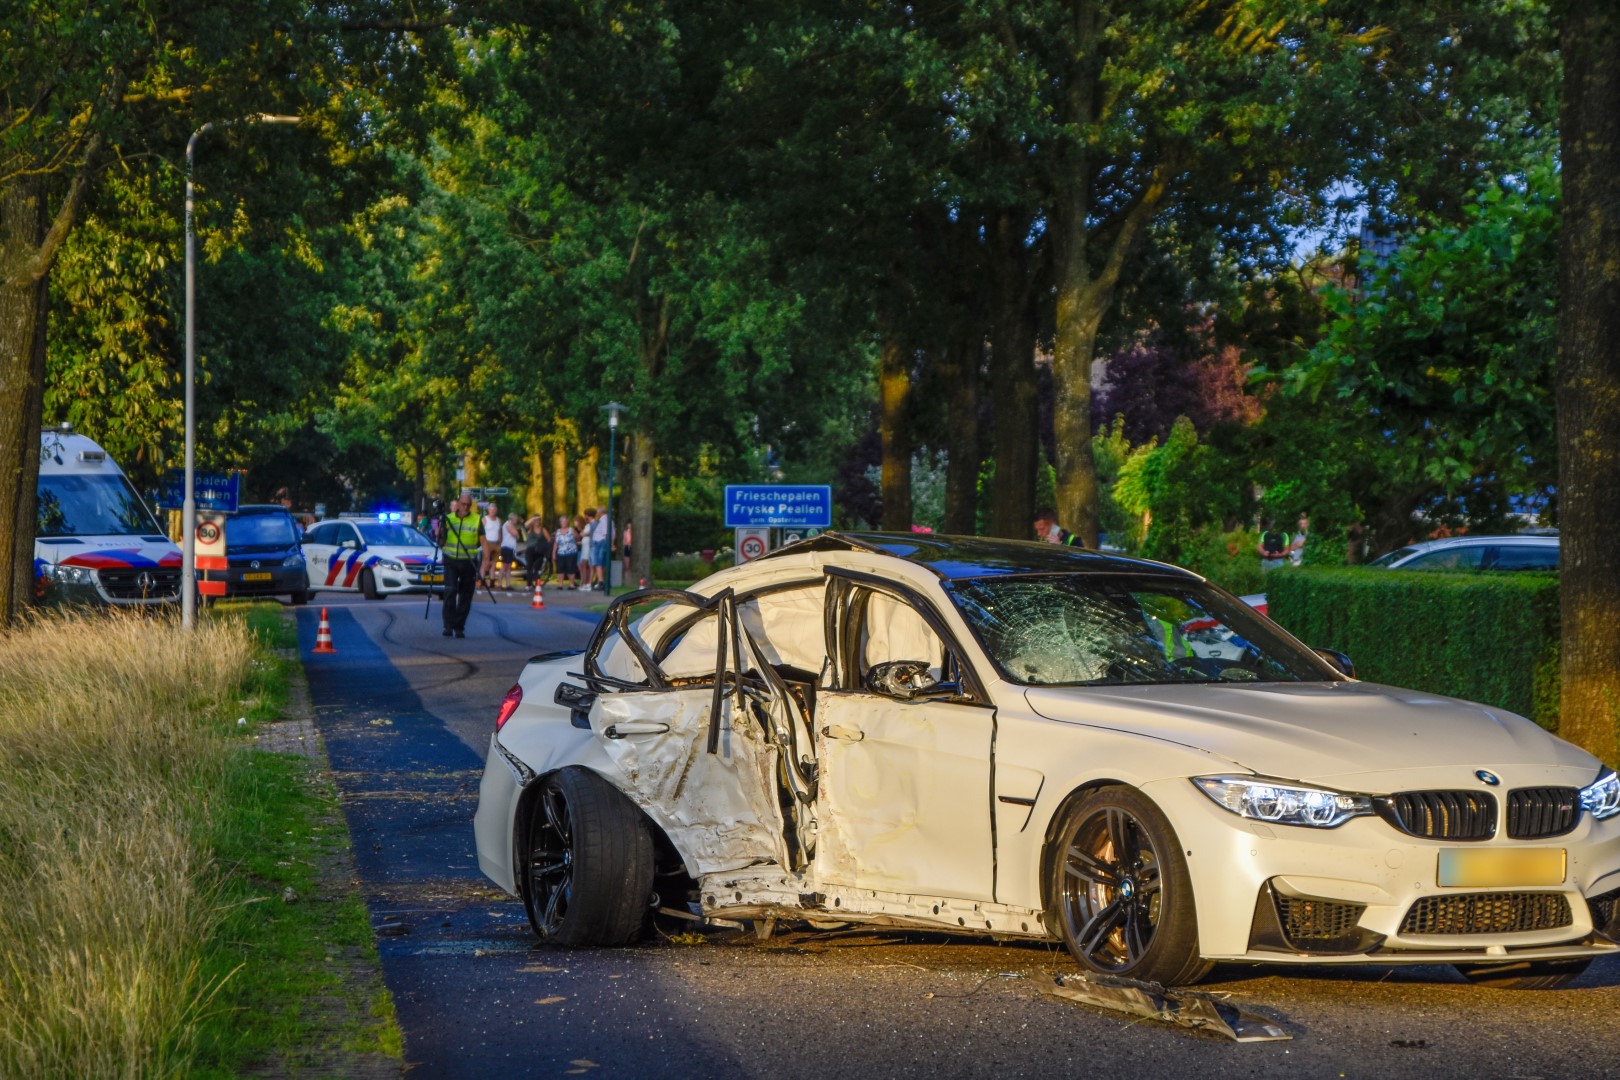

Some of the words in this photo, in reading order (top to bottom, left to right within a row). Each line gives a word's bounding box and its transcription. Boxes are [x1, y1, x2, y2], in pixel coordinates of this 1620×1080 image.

[193, 487, 231, 500] eallen
[736, 490, 820, 503] Frieschepalen
[733, 503, 775, 516] Fryske
[778, 503, 823, 514] Peallen
[200, 528, 216, 538] 30
[746, 543, 761, 553] 30
